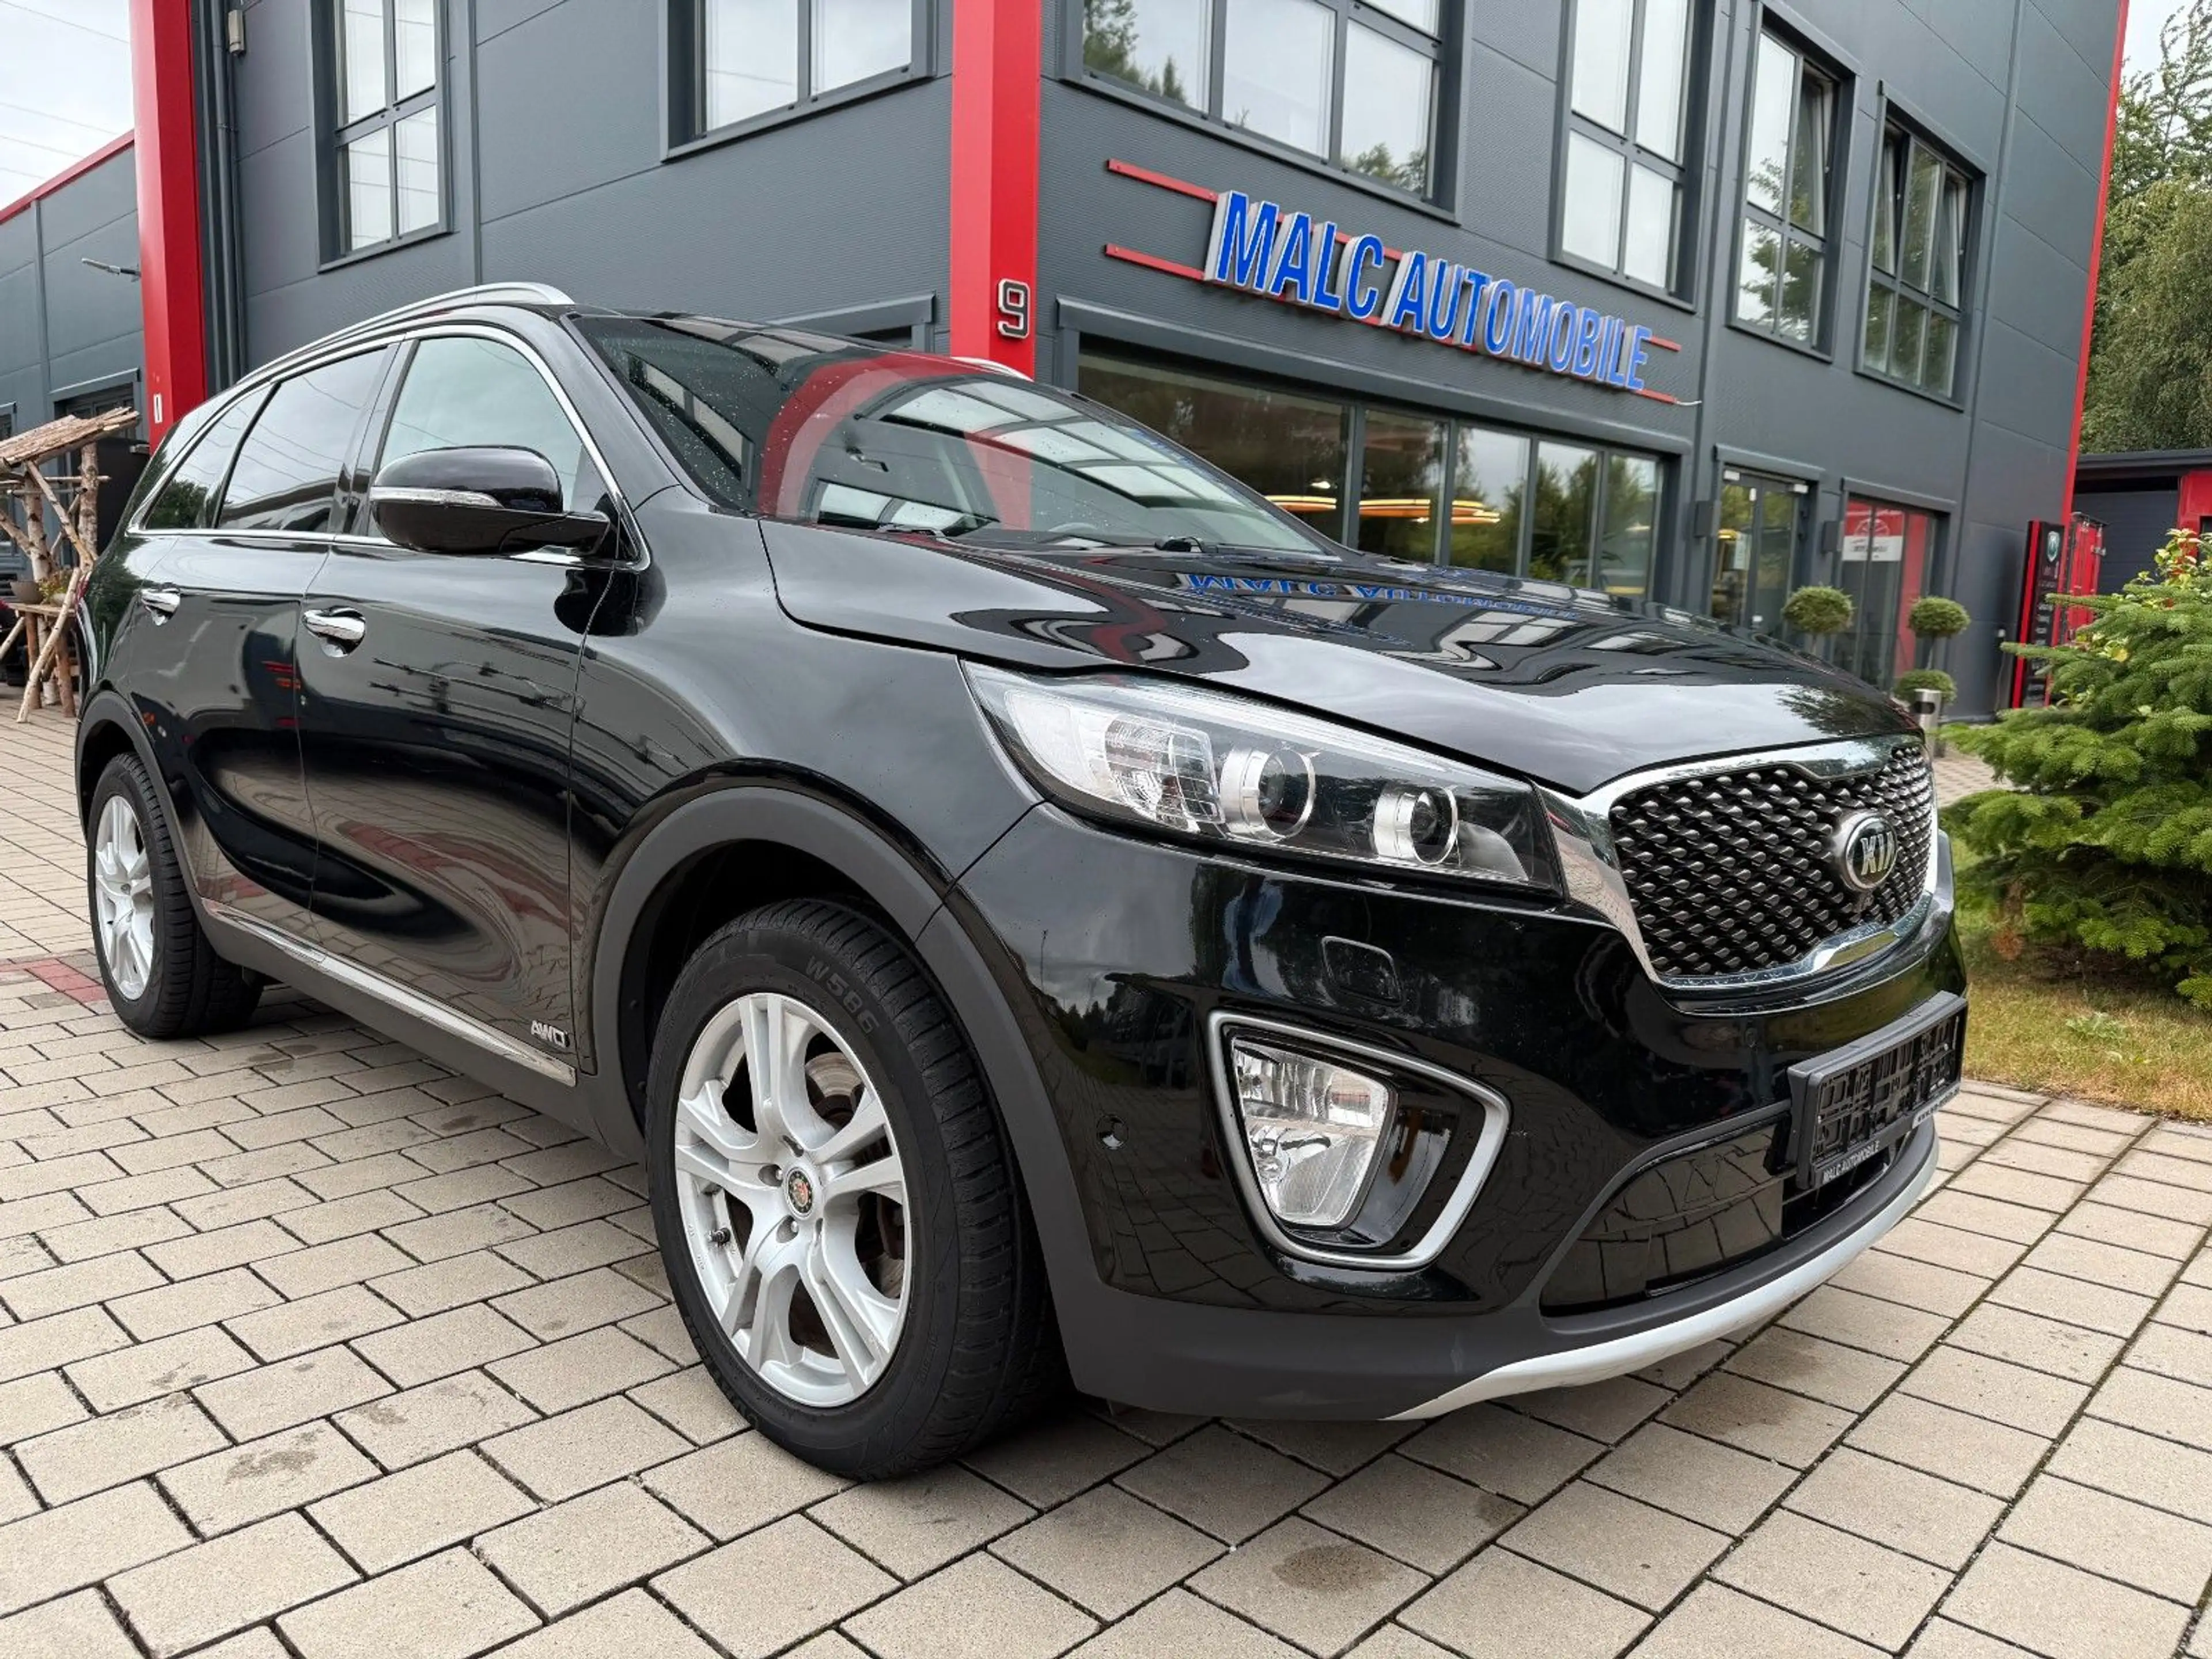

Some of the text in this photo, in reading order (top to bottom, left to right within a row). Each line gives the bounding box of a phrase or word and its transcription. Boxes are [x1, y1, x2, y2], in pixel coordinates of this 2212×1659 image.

[997, 278, 1031, 339] 9
[1207, 190, 1653, 392] MALC AUTOMOBILE
[1859, 830, 1896, 876] KIA
[806, 954, 881, 1035] W586
[530, 1019, 569, 1049] AWD
